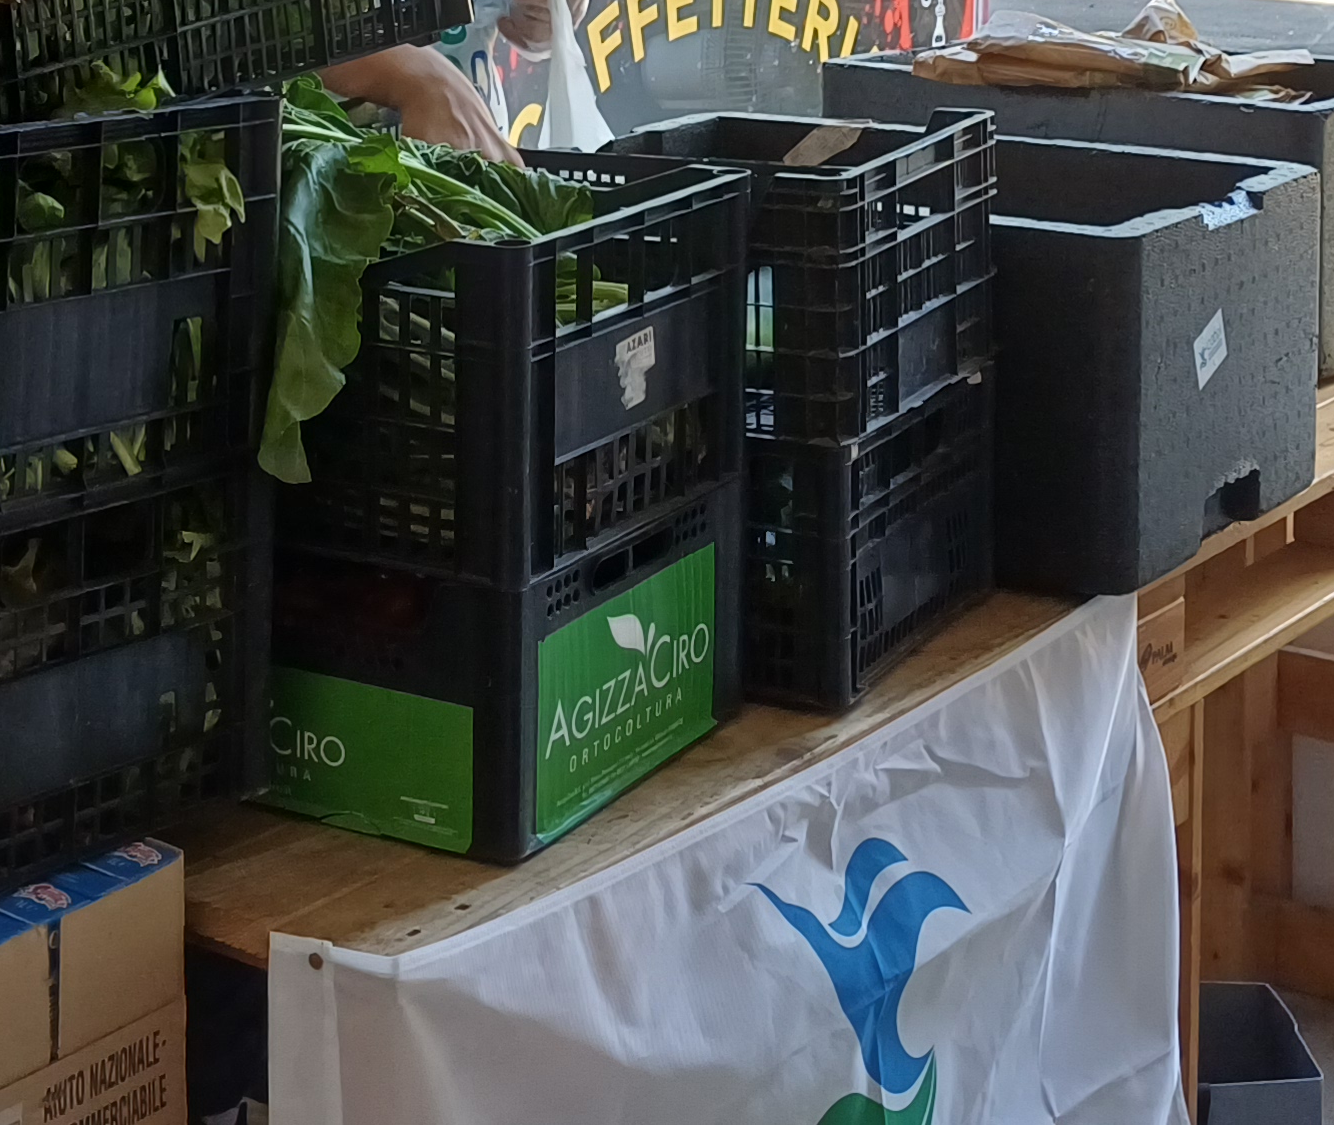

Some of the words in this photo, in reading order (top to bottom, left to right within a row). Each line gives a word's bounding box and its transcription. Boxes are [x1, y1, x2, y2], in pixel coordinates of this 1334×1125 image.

[569, 686, 683, 773] ORTOCOLTURA
[42, 1069, 86, 1123] AIUTO
[89, 1029, 161, 1100] NAZIONALE
[69, 1073, 167, 1125] ERCIABILE
